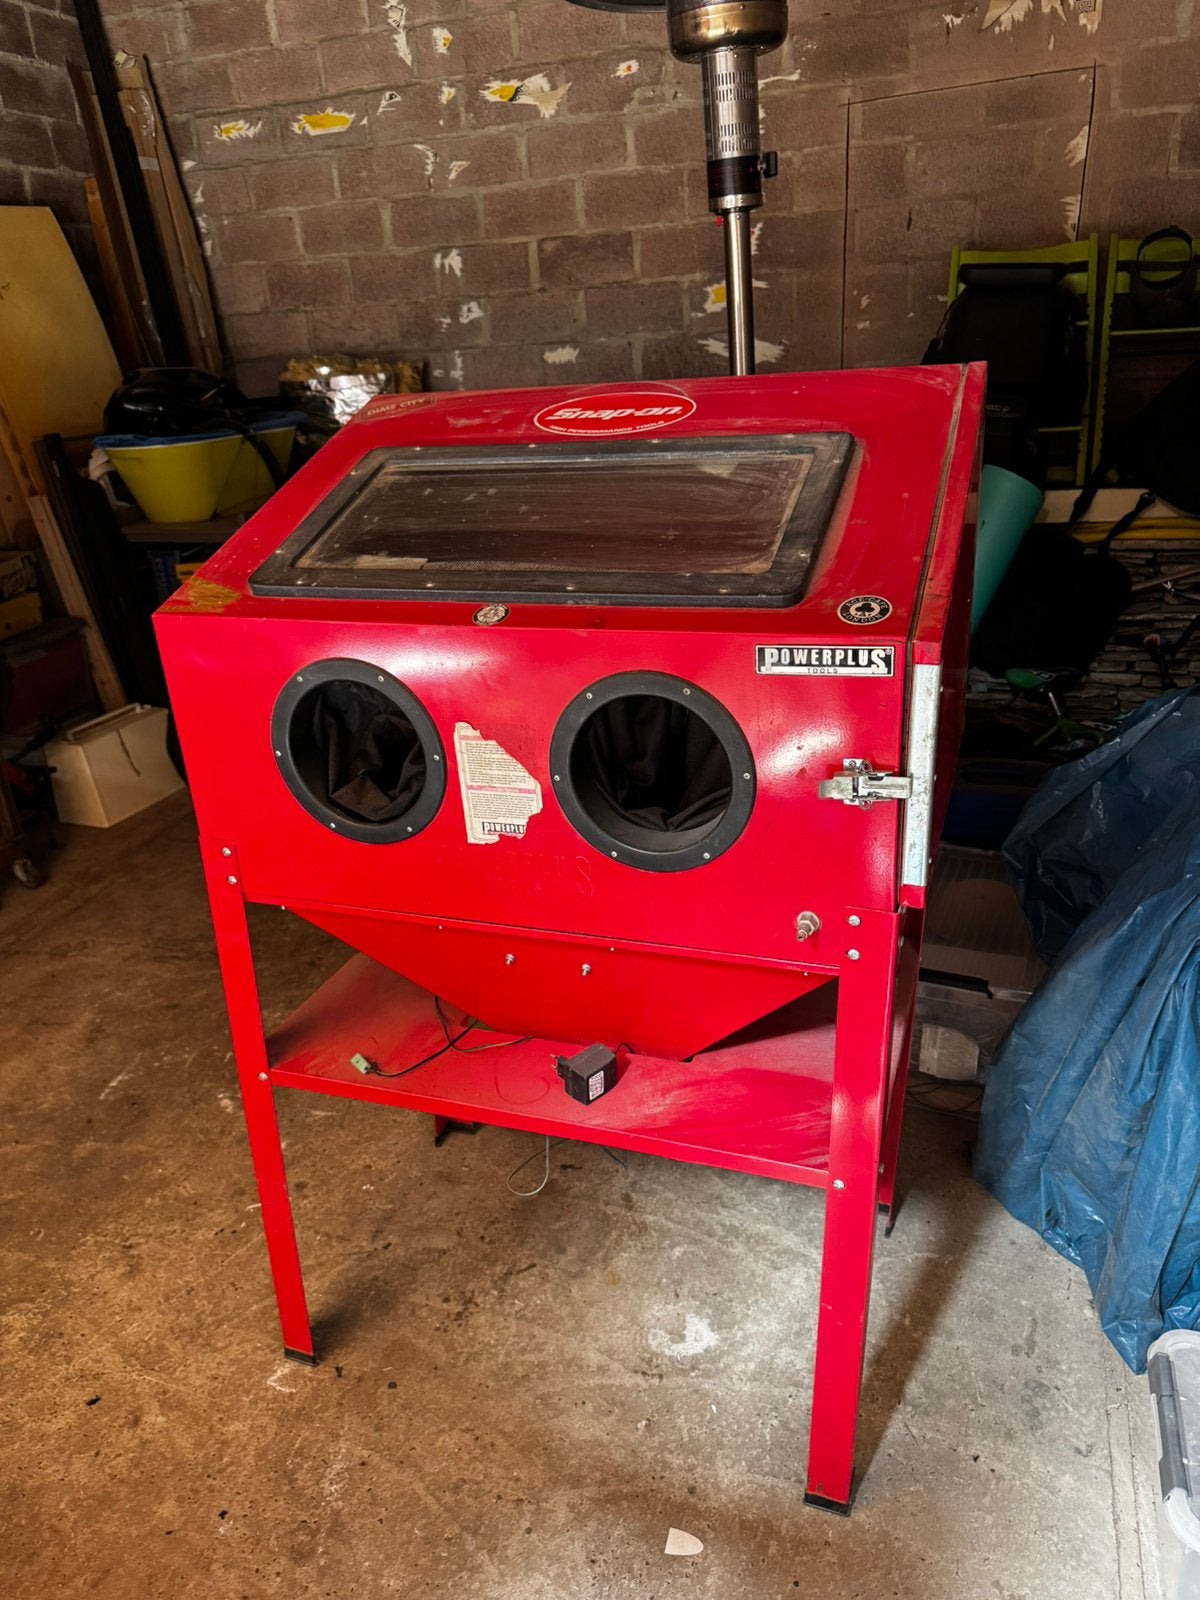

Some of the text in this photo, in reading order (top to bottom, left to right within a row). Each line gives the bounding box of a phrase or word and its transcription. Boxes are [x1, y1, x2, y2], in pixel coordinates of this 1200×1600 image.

[367, 398, 425, 416] DIME CITY
[545, 406, 683, 420] Snap-on
[567, 426, 632, 434] PERFORMANCE
[635, 420, 665, 430] TOOLS
[842, 611, 882, 623] LONDON
[807, 667, 838, 675] TOOLS
[483, 822, 525, 835] POWERPLU
